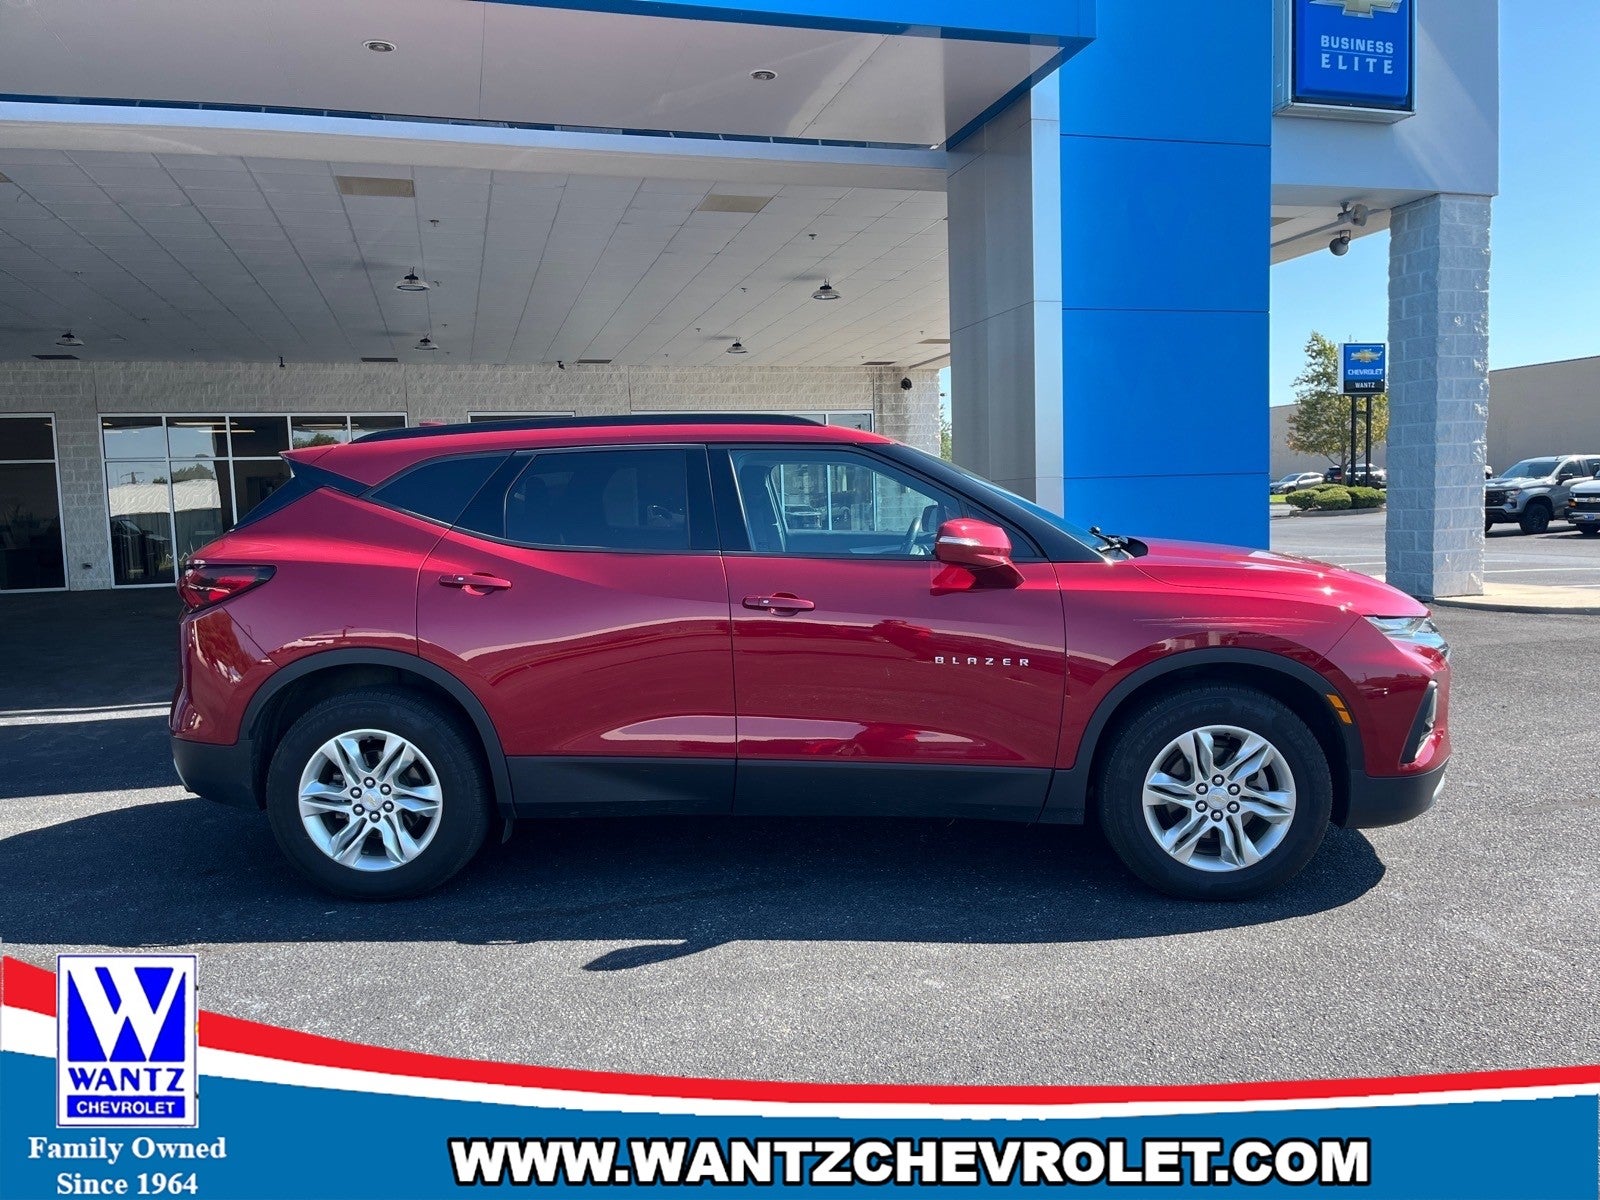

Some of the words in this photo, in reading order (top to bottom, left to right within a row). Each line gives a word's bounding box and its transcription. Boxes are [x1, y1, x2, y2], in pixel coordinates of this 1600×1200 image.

[1321, 35, 1394, 54] BUSINESS
[1321, 53, 1394, 75] ELITE
[934, 656, 1029, 666] BLAZER
